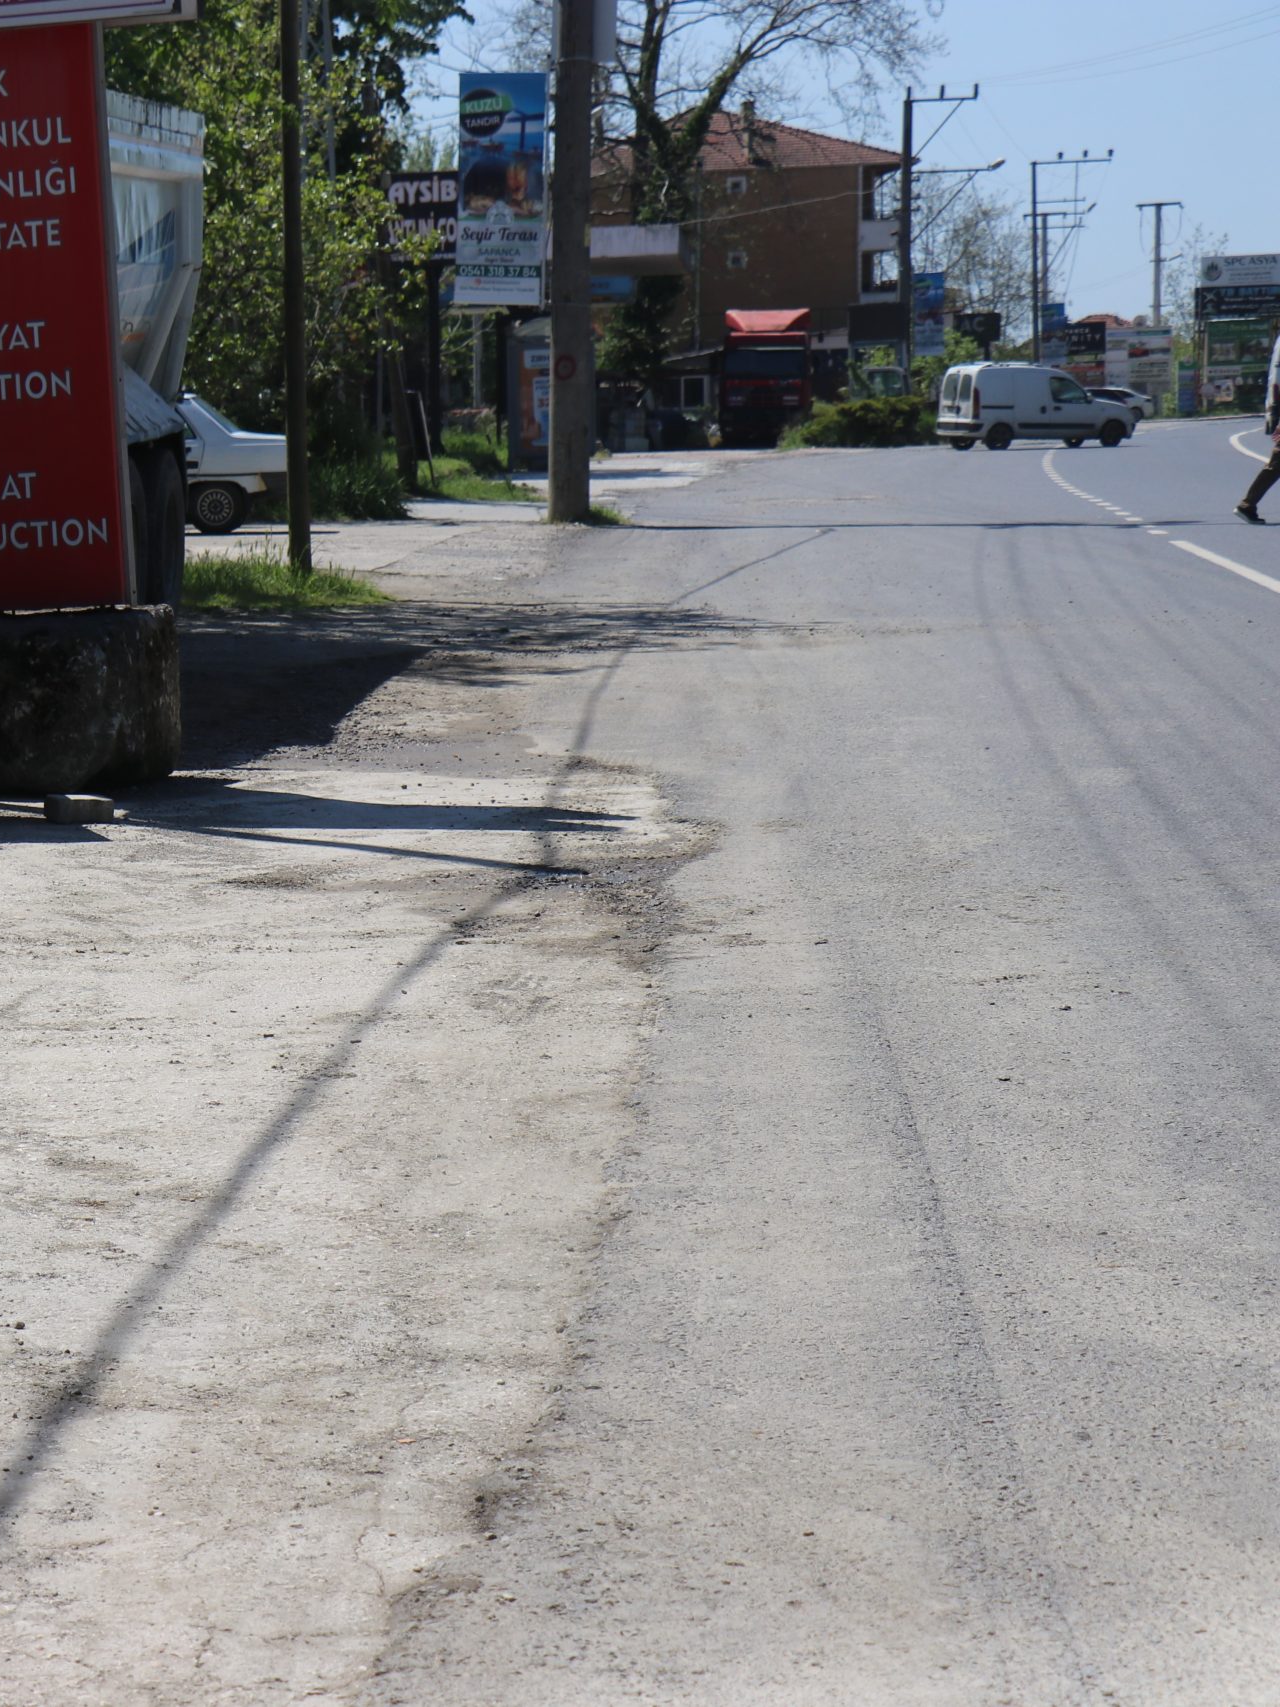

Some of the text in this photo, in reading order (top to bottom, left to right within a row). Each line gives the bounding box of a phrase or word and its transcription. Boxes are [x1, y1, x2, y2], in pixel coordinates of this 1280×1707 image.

[465, 98, 502, 113] KUZU
[461, 226, 538, 244] Seyir Terası
[460, 265, 537, 277] 0541 318 37 84
